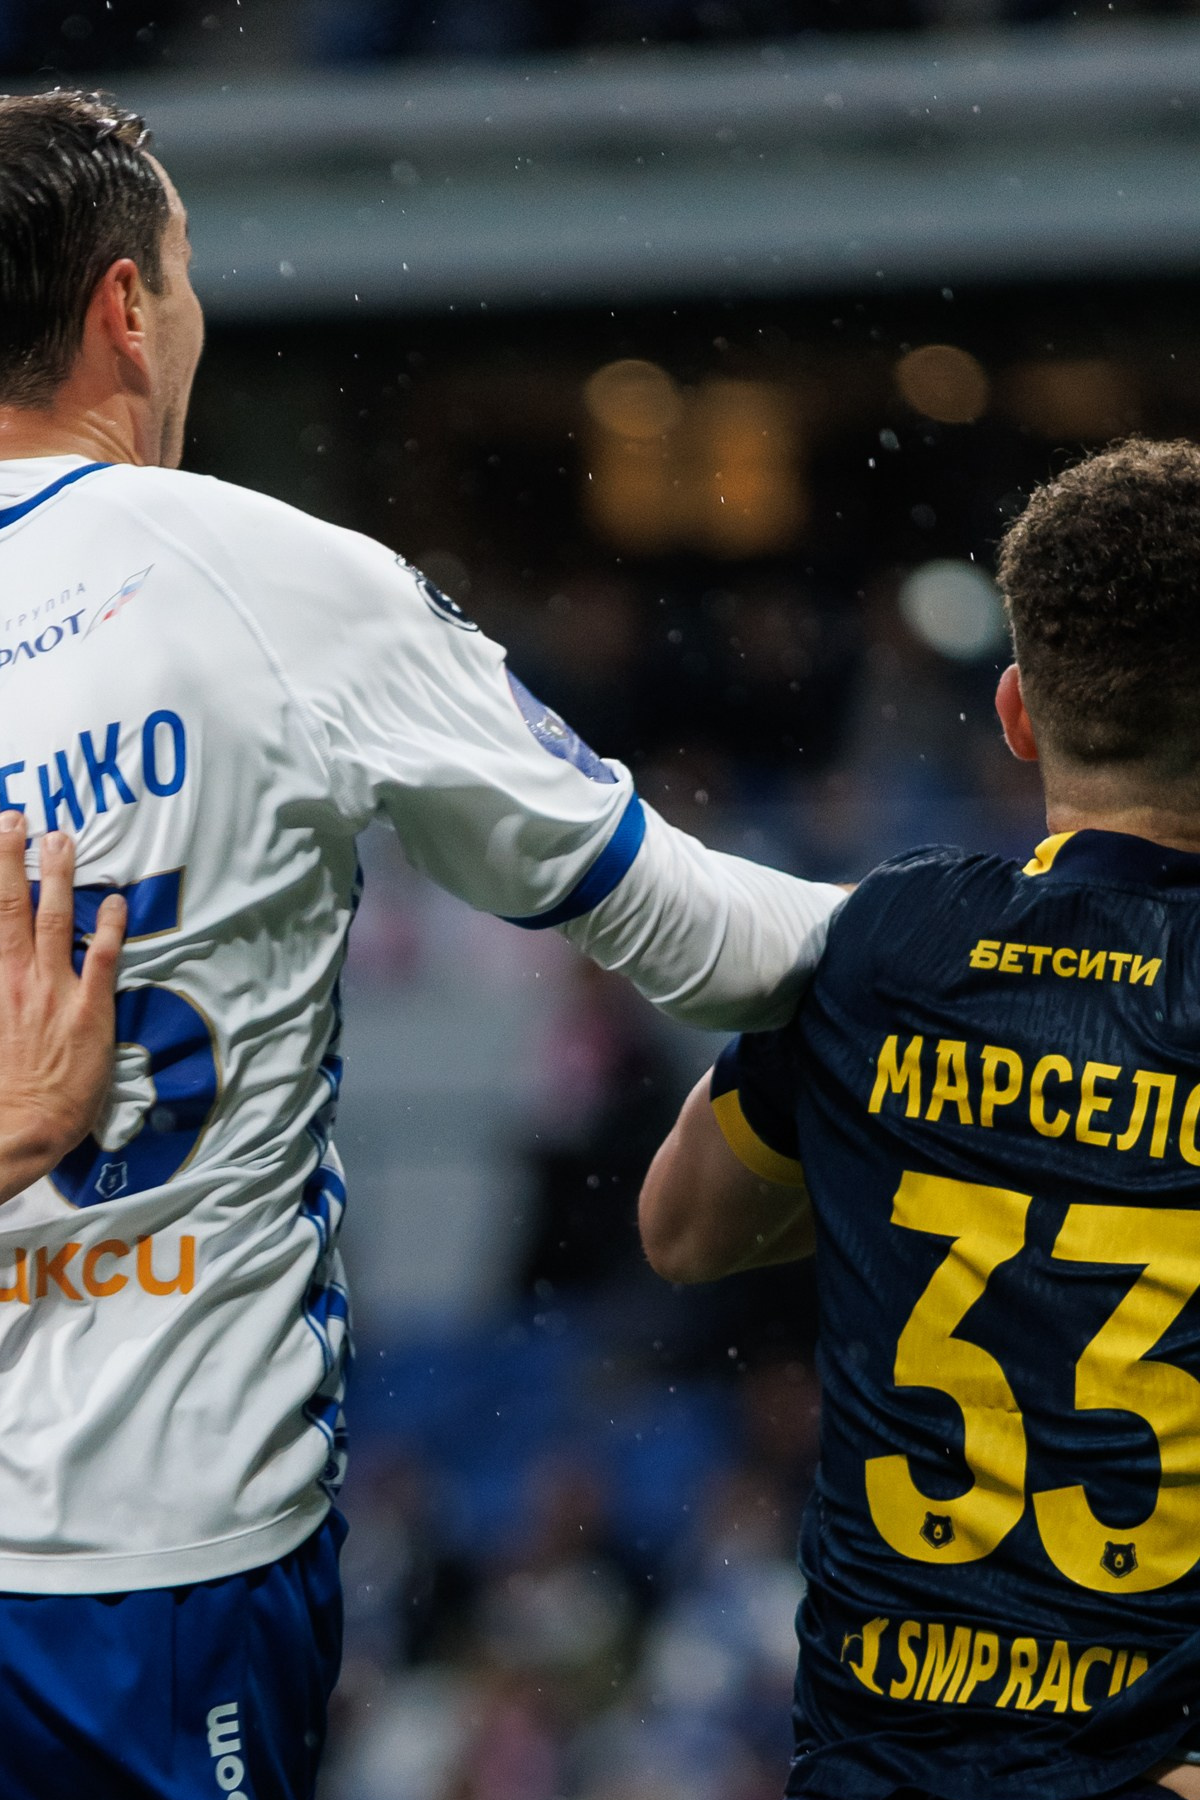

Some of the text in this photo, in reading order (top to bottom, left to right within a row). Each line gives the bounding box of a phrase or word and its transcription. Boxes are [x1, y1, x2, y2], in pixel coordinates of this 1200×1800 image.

[3, 582, 88, 631] ГРУППА
[969, 940, 1162, 987] БЕТСИТИ
[865, 1170, 1200, 1593] 33
[890, 1620, 1000, 1703] SMP
